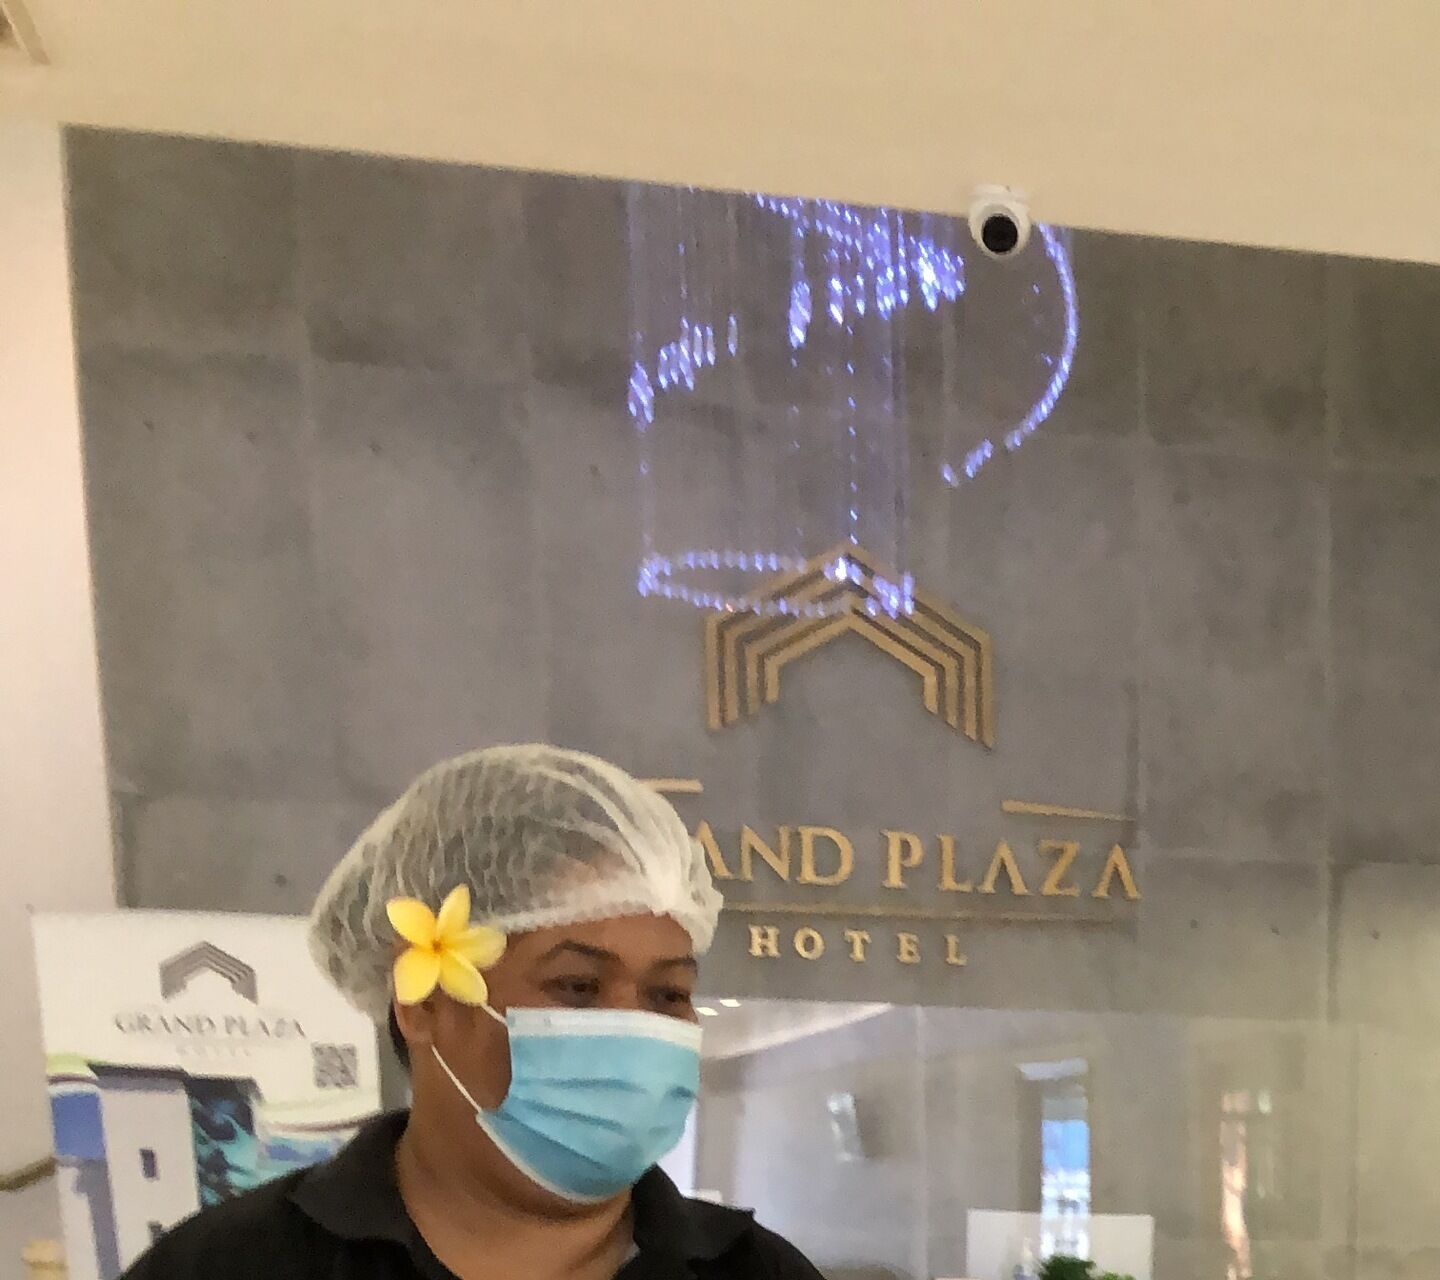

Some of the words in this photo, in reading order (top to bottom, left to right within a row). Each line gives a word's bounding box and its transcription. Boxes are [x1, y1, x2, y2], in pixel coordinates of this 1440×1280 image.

[696, 820, 856, 887] AND
[882, 829, 1142, 900] PLAZA
[747, 924, 968, 967] HOTEL
